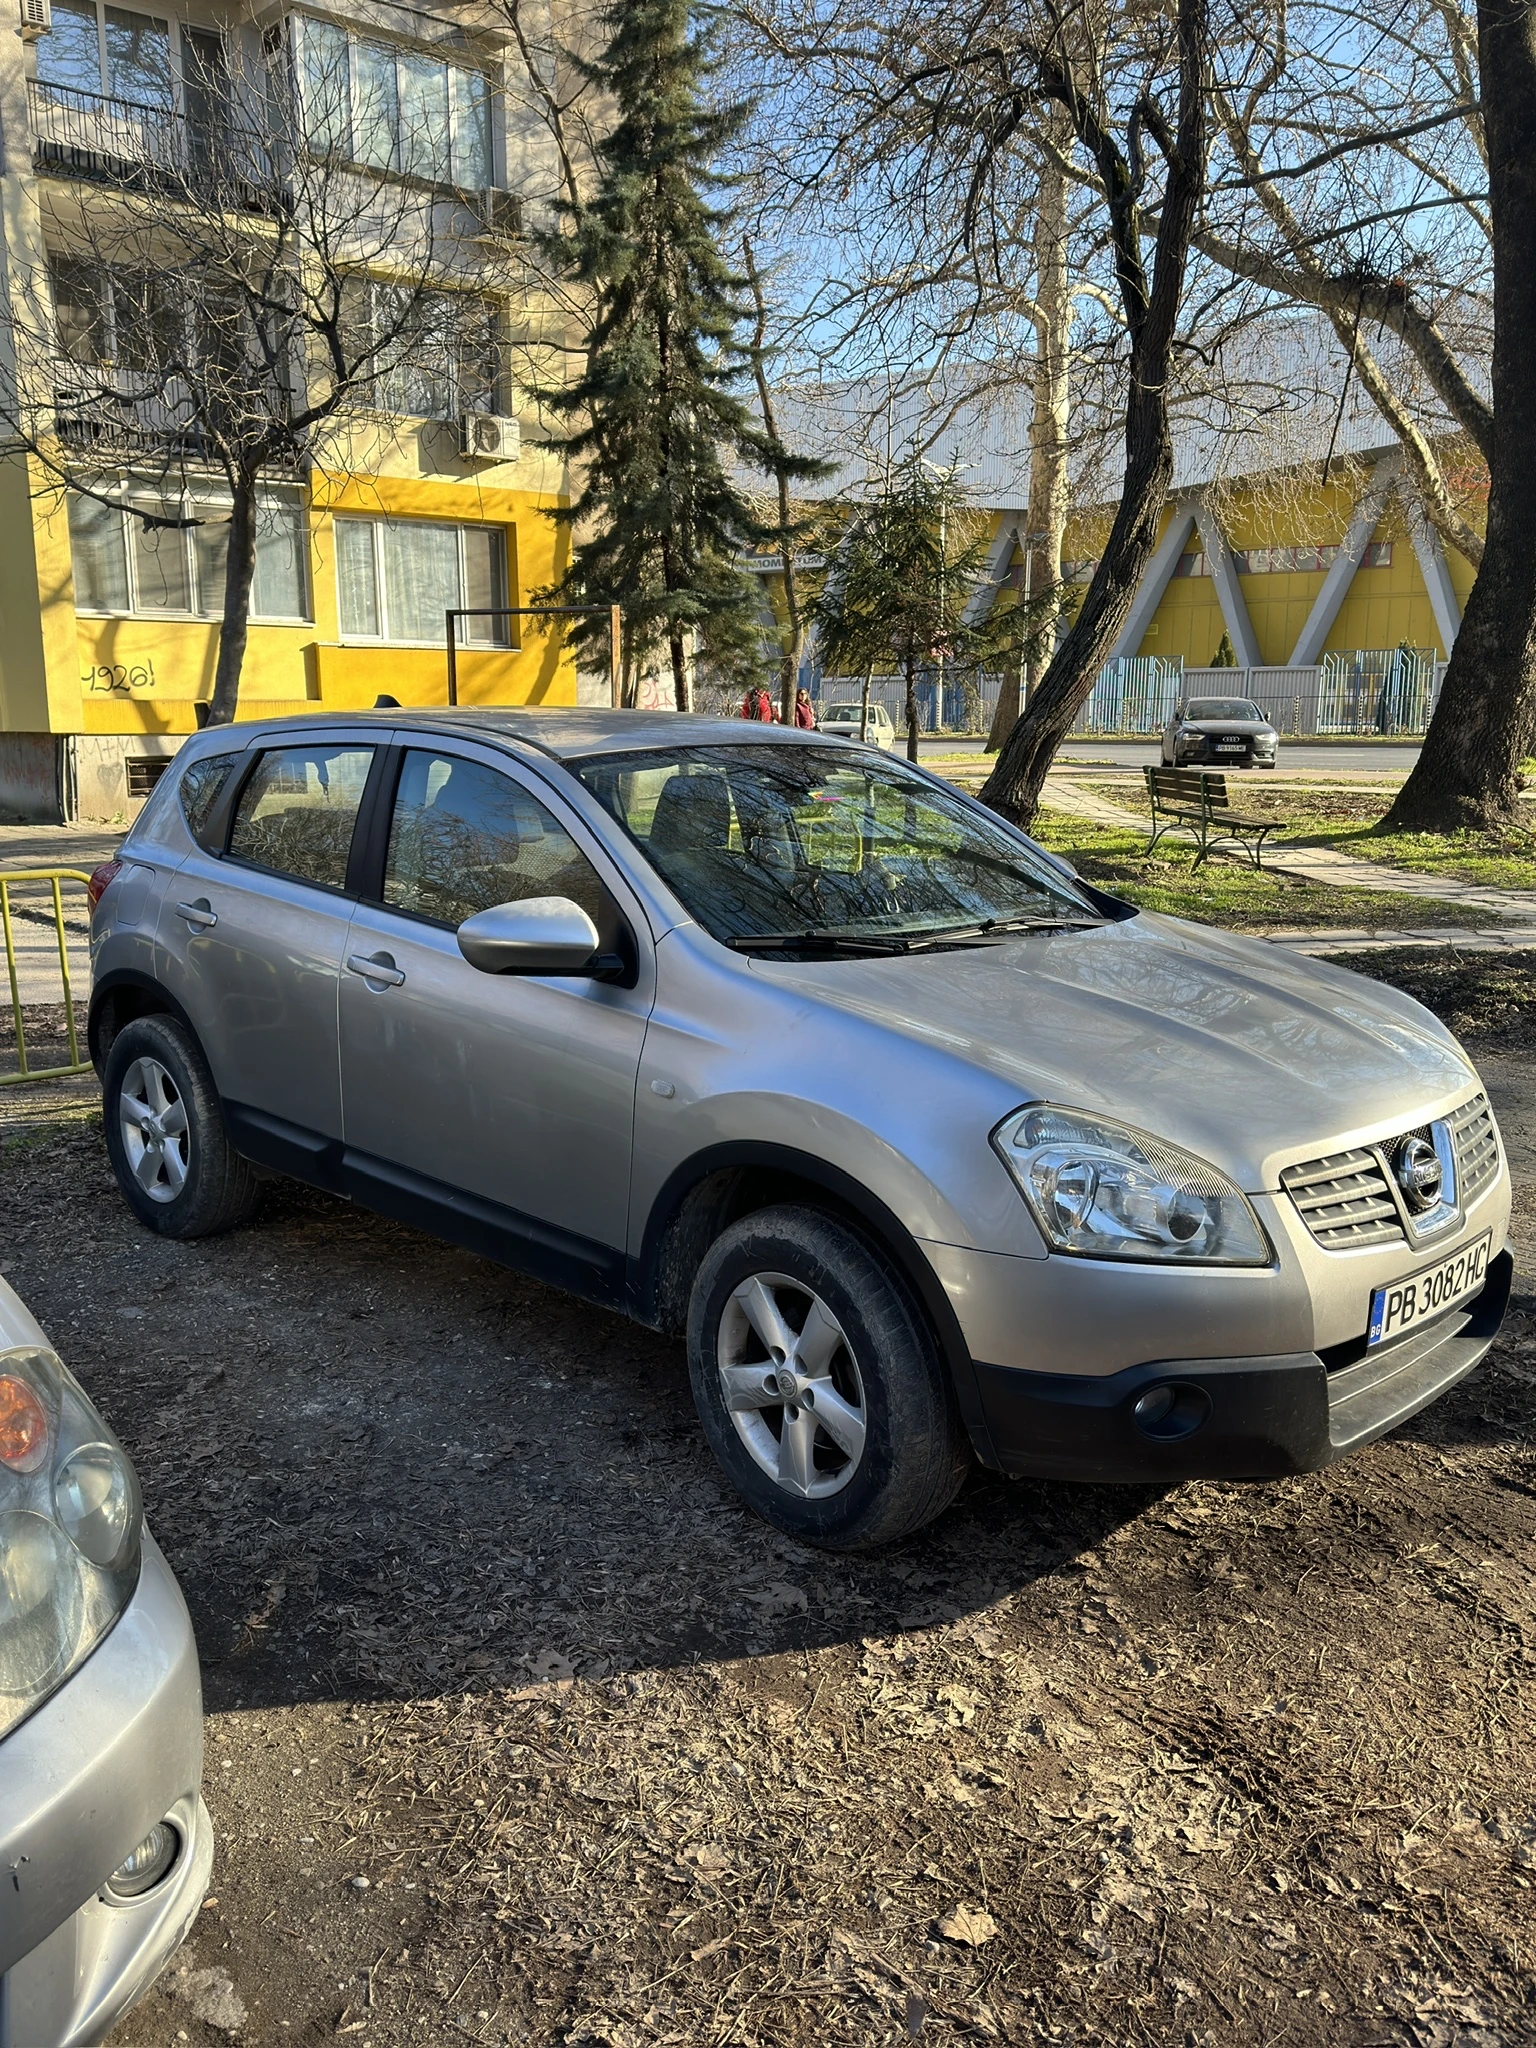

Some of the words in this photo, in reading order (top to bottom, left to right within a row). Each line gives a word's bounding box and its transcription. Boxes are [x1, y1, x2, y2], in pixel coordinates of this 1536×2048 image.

[81, 658, 155, 692] 1926!
[1385, 1284, 1416, 1333] PB
[1418, 1257, 1465, 1315] 3082
[1464, 1242, 1487, 1289] HC
[1370, 1324, 1381, 1338] BG
